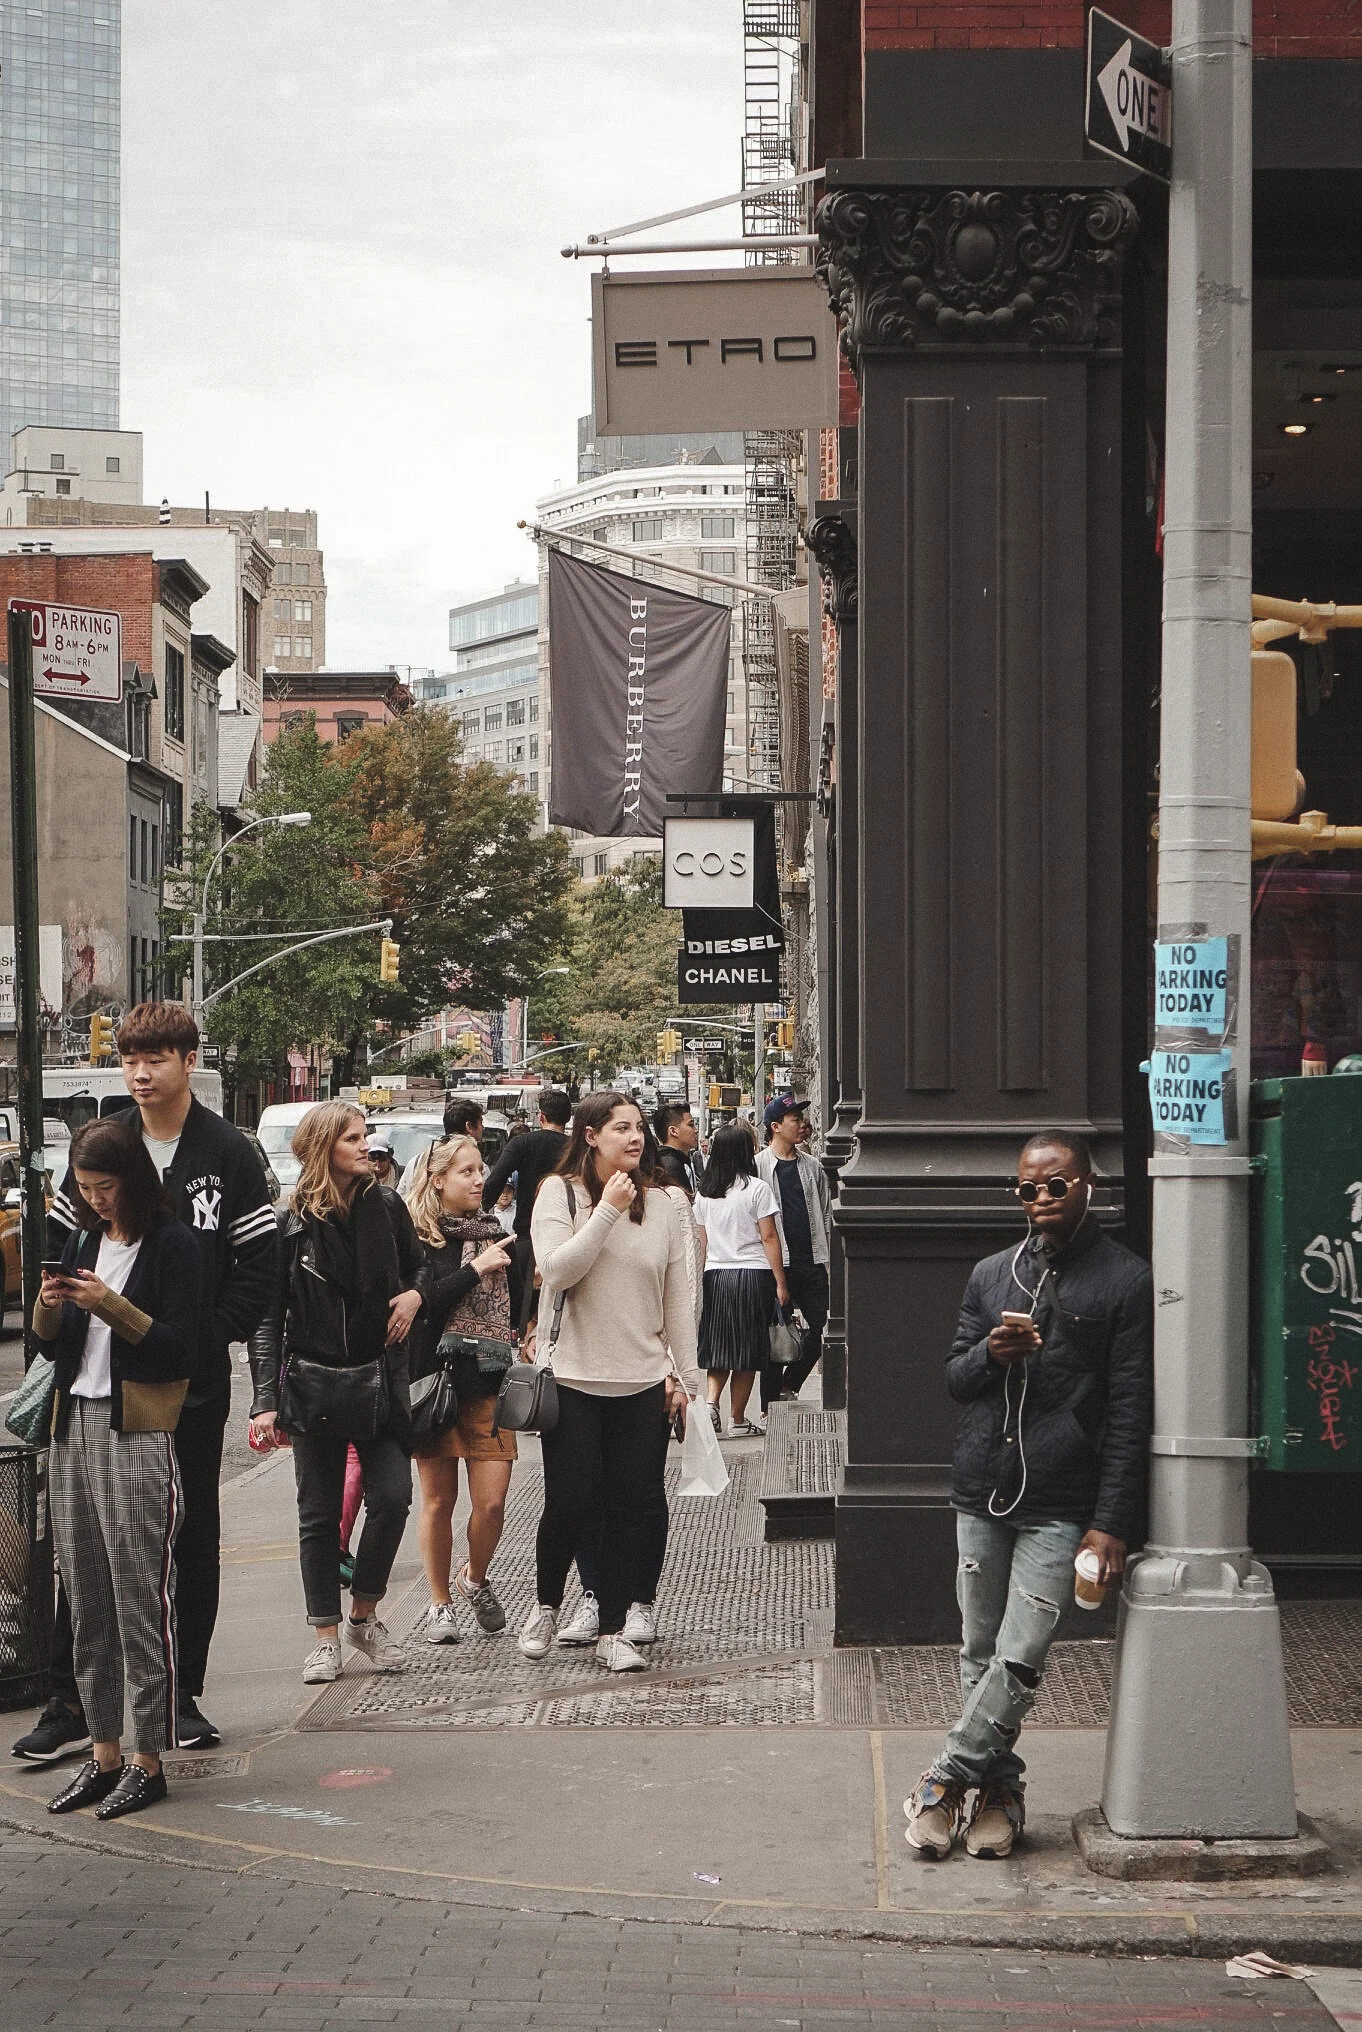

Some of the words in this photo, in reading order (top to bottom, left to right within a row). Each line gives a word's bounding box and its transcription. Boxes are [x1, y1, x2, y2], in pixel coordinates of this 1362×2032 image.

[1117, 68, 1159, 135] ONE
[52, 611, 112, 635] PARKING
[42, 653, 61, 664] MON
[77, 657, 91, 667] FRI
[623, 596, 648, 823] BURBERRY
[673, 852, 746, 877] COS
[687, 934, 781, 954] DIESEL
[1171, 945, 1197, 965] NO
[685, 968, 772, 984] CHANEL
[1159, 969, 1228, 989] ARKING
[1160, 993, 1215, 1012] TODAY
[1165, 1054, 1190, 1074] NO
[186, 1176, 207, 1193] NEW
[192, 1189, 221, 1230] NY
